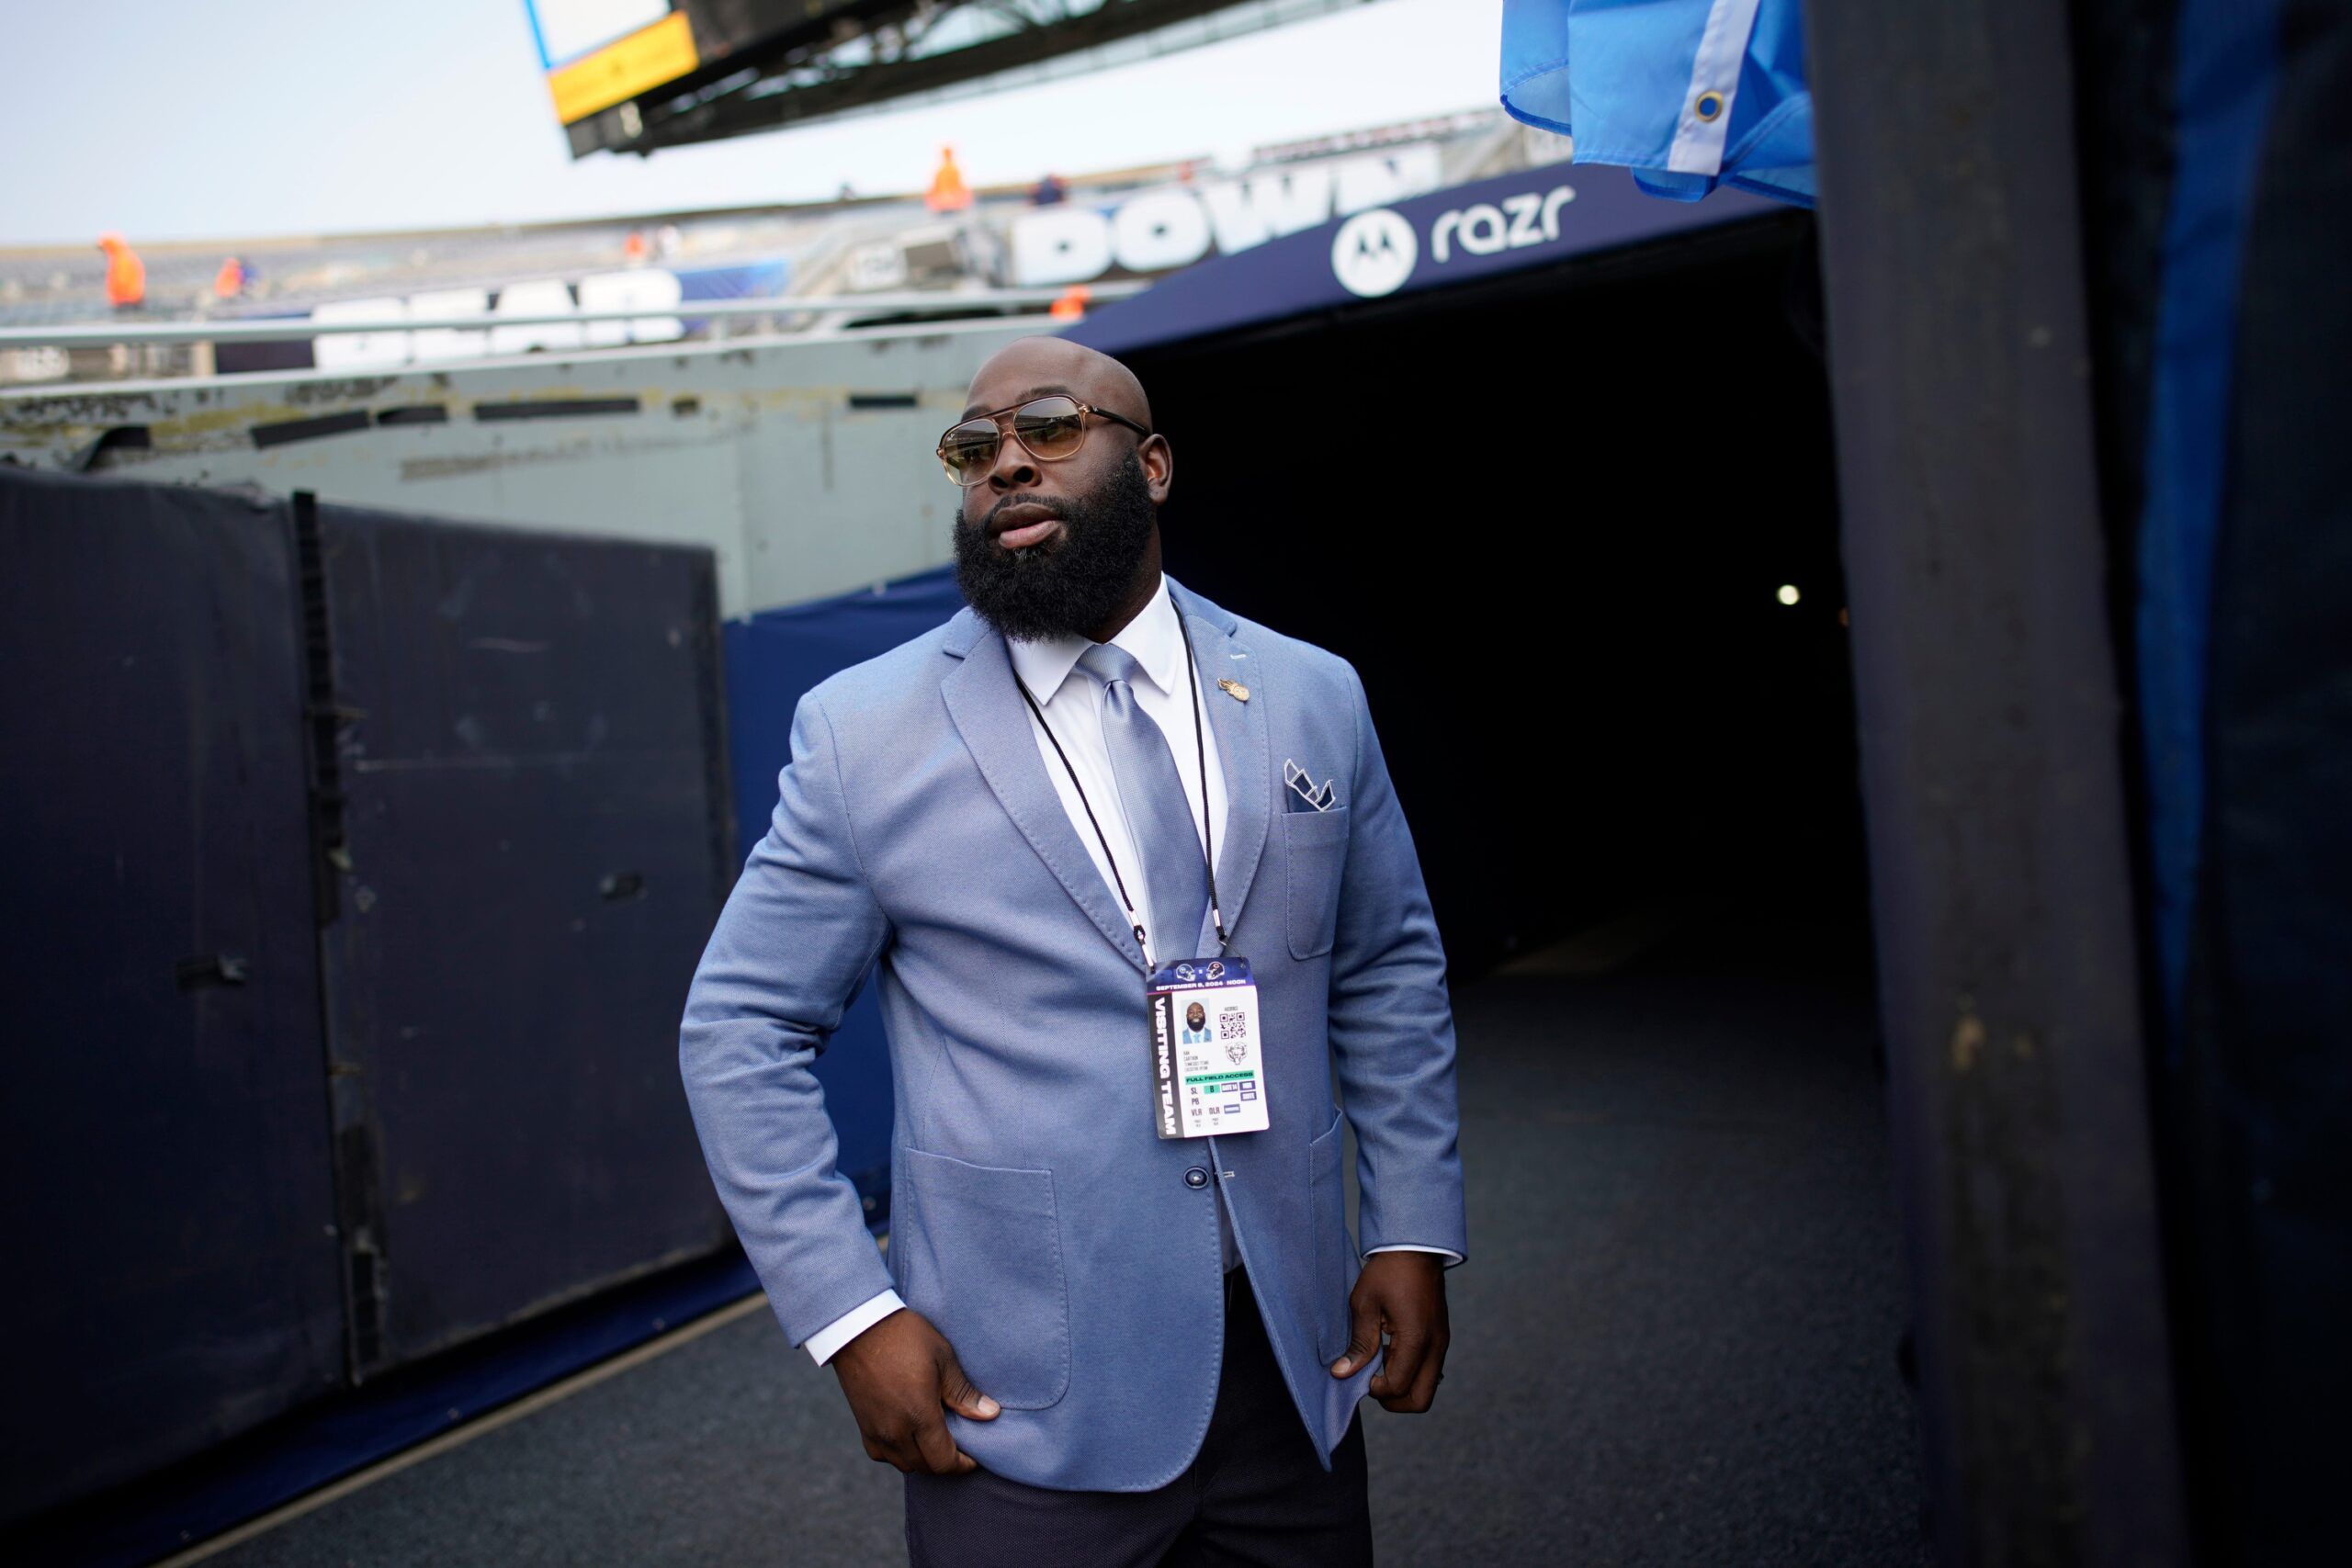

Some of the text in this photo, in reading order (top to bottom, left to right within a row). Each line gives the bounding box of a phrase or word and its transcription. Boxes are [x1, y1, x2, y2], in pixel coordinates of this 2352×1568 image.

[1014, 142, 1441, 286] DOWN
[1430, 185, 1577, 264] razr
[1156, 983, 1196, 991] SEPTEMBER
[1155, 997, 1176, 1134] VISITING TEAM
